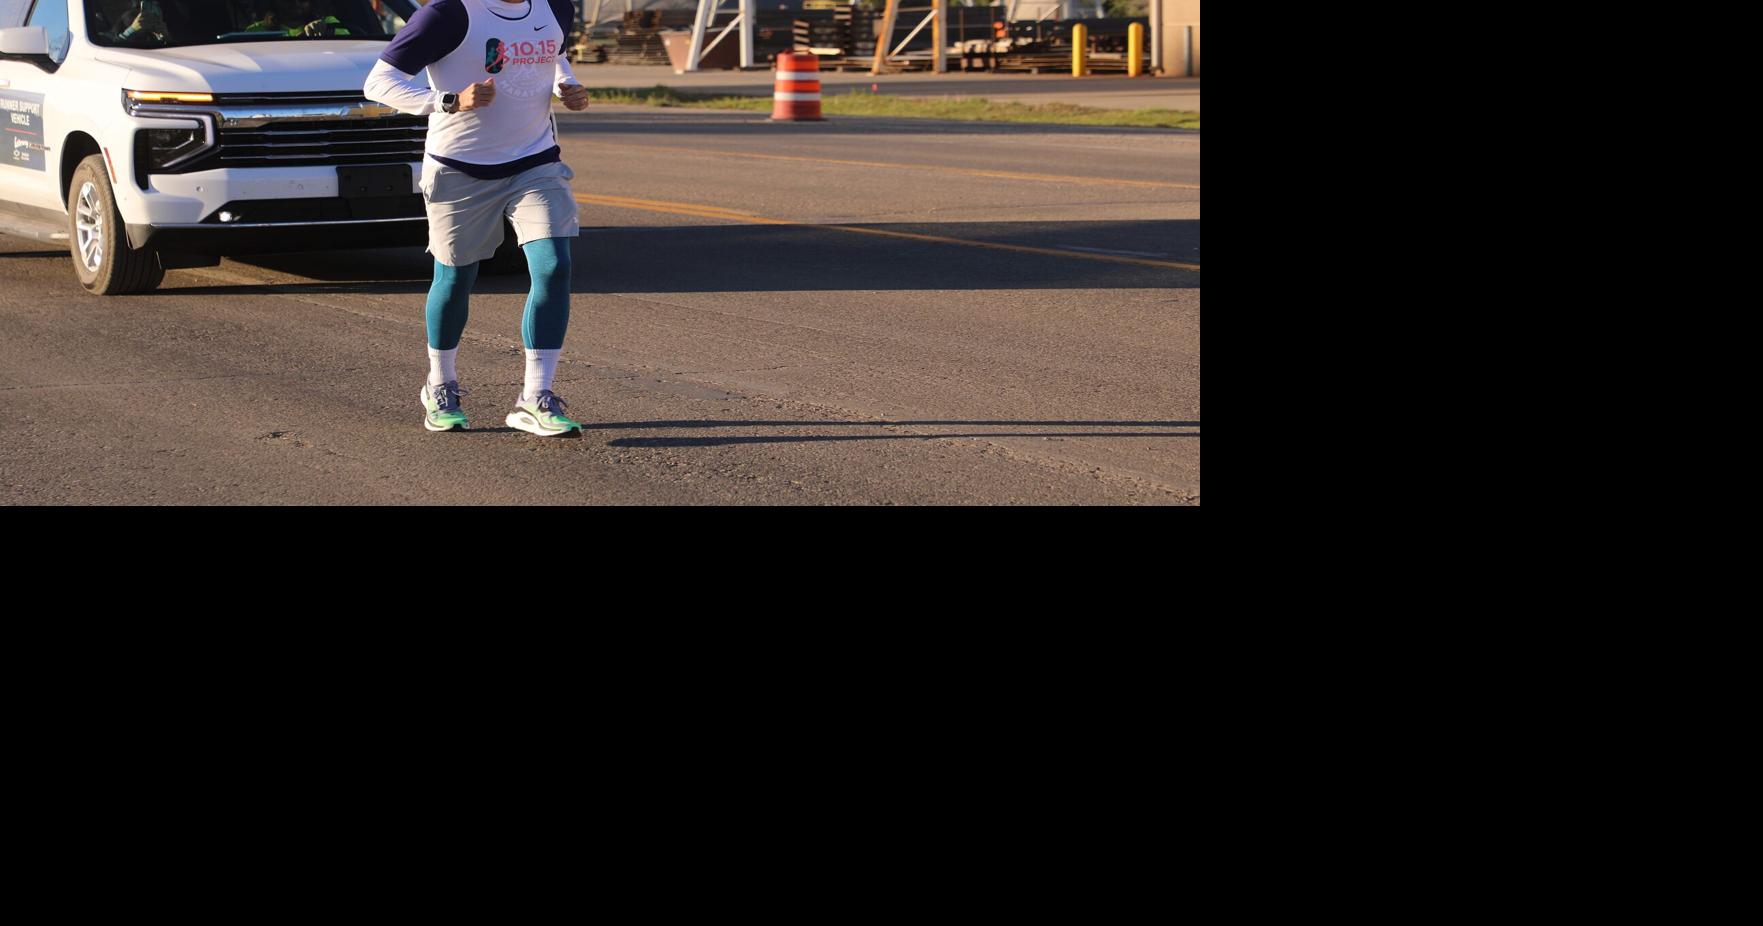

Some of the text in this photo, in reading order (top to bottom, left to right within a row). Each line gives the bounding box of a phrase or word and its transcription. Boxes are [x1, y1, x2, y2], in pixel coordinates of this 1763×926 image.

[510, 40, 556, 56] 10.15
[512, 56, 555, 65] PROJECT
[19, 100, 40, 116] SUPPORT
[11, 113, 30, 126] VEHICLE
